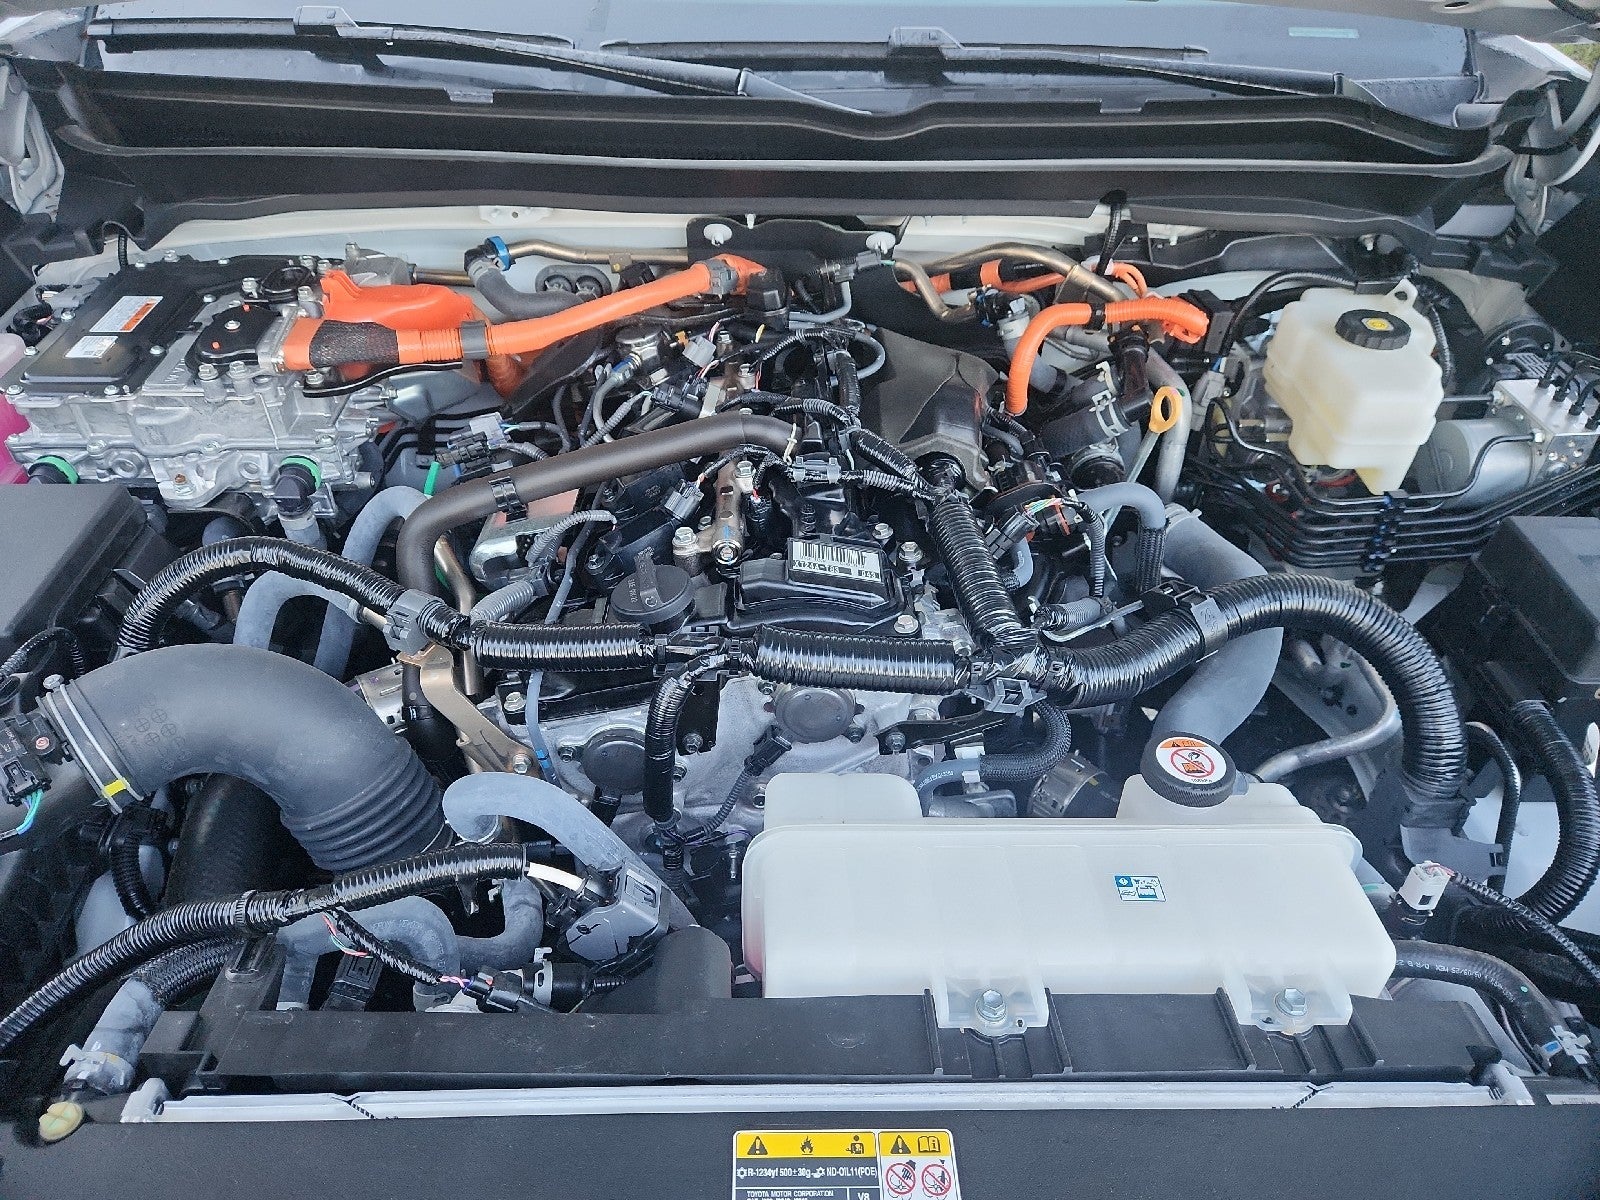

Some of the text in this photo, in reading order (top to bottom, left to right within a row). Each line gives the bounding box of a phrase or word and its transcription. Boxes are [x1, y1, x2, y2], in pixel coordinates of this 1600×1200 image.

[747, 1167, 779, 1179] R-1234yf
[826, 1166, 878, 1179] ND-OIL11(POE)
[746, 1189, 834, 1198] TOYOTA MOTOR CORPORATION
